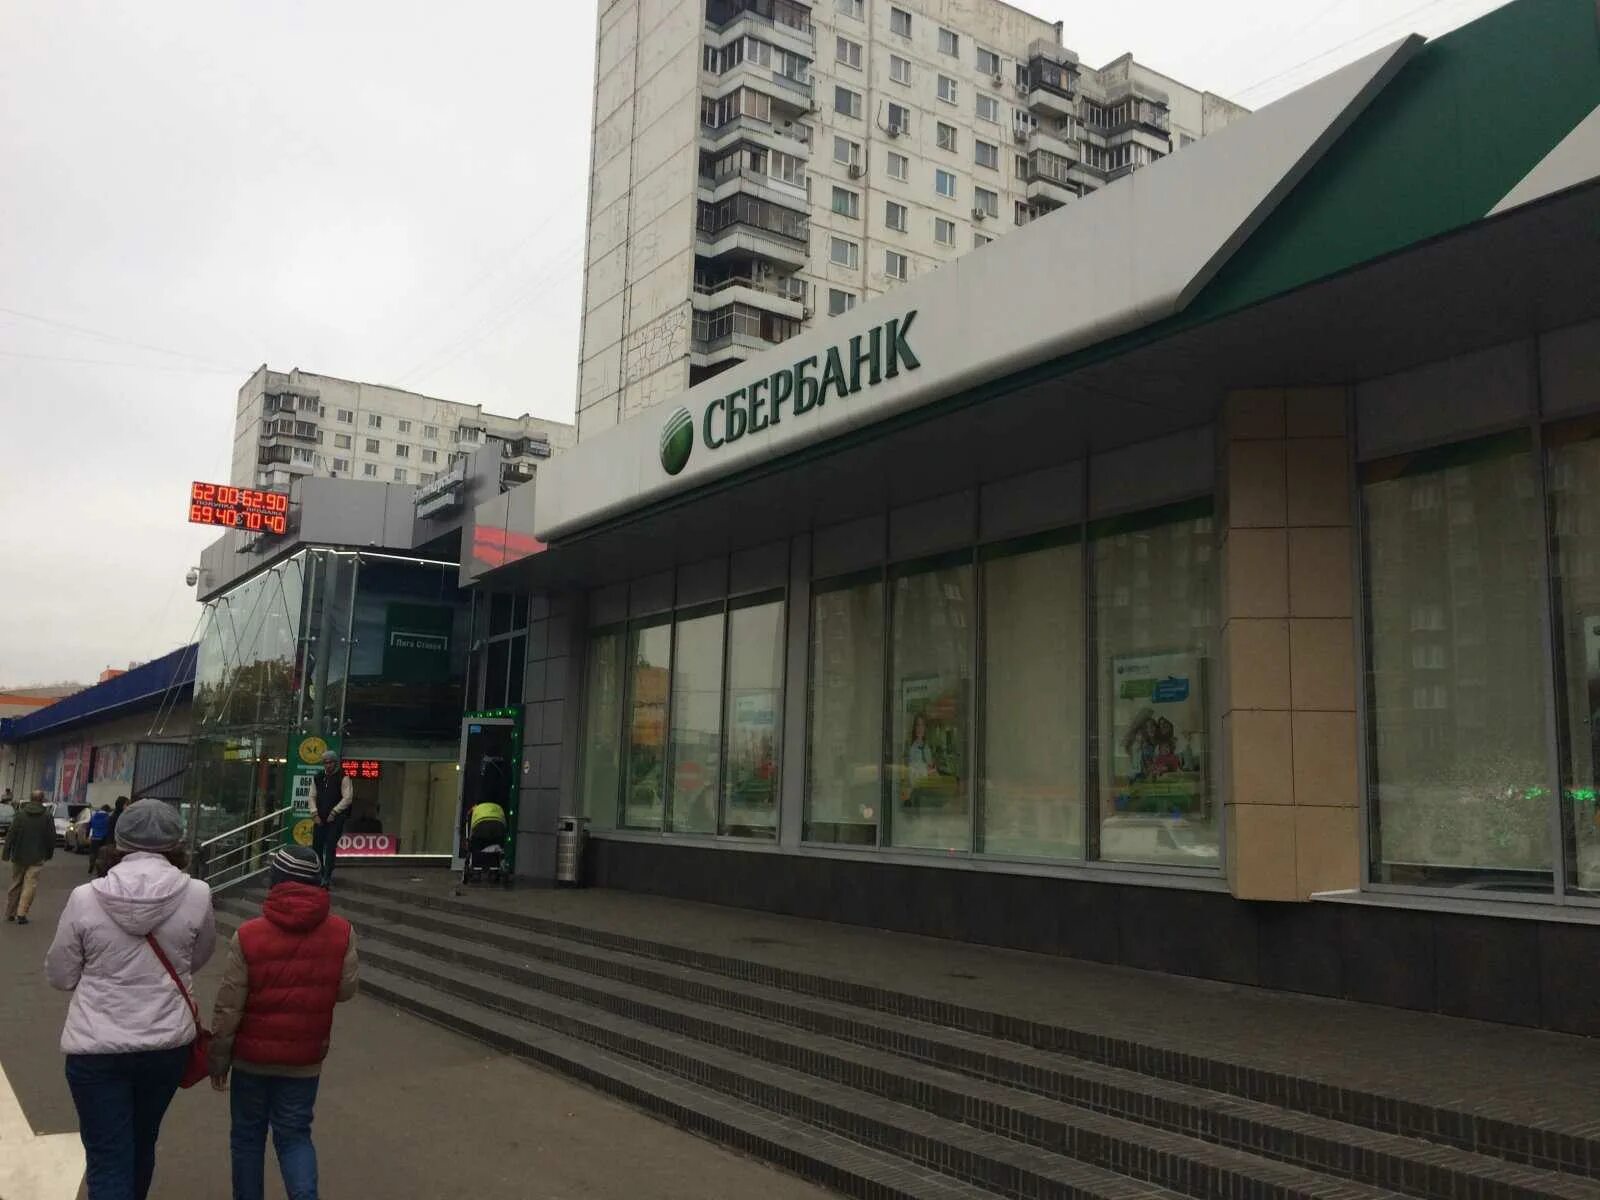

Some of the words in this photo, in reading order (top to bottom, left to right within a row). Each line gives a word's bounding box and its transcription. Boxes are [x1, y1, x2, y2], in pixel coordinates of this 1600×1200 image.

[702, 310, 921, 449] СБЕРБАНК
[242, 490, 287, 511] 62.90
[191, 504, 237, 526] 69.40
[337, 835, 389, 850] ФОТО
